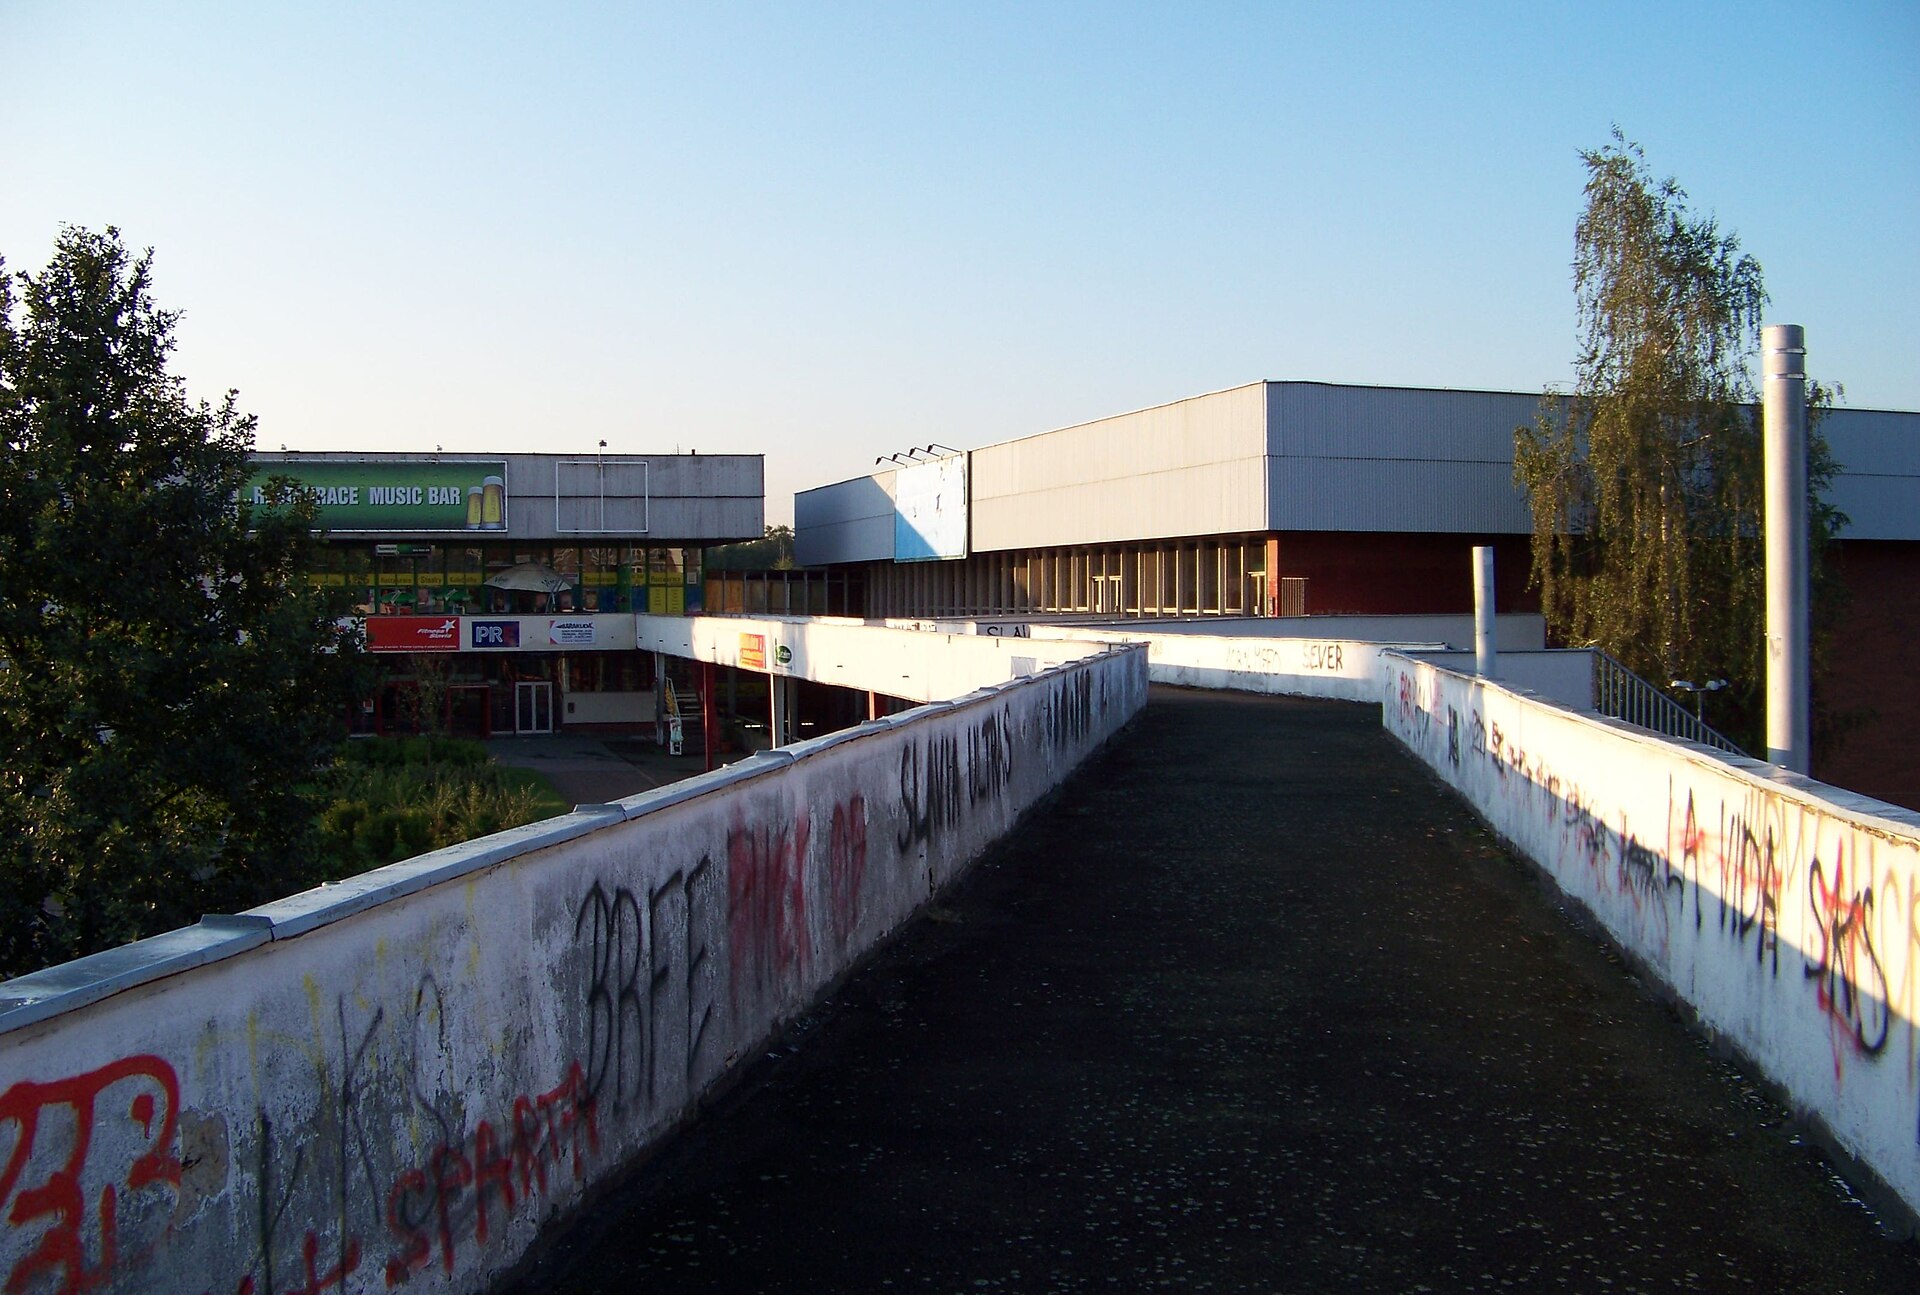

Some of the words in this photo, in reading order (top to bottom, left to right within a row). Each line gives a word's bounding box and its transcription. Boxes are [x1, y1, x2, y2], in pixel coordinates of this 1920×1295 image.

[369, 486, 424, 505] MUSIC
[429, 486, 462, 505] BAR
[386, 1059, 599, 1288] SPARTA
